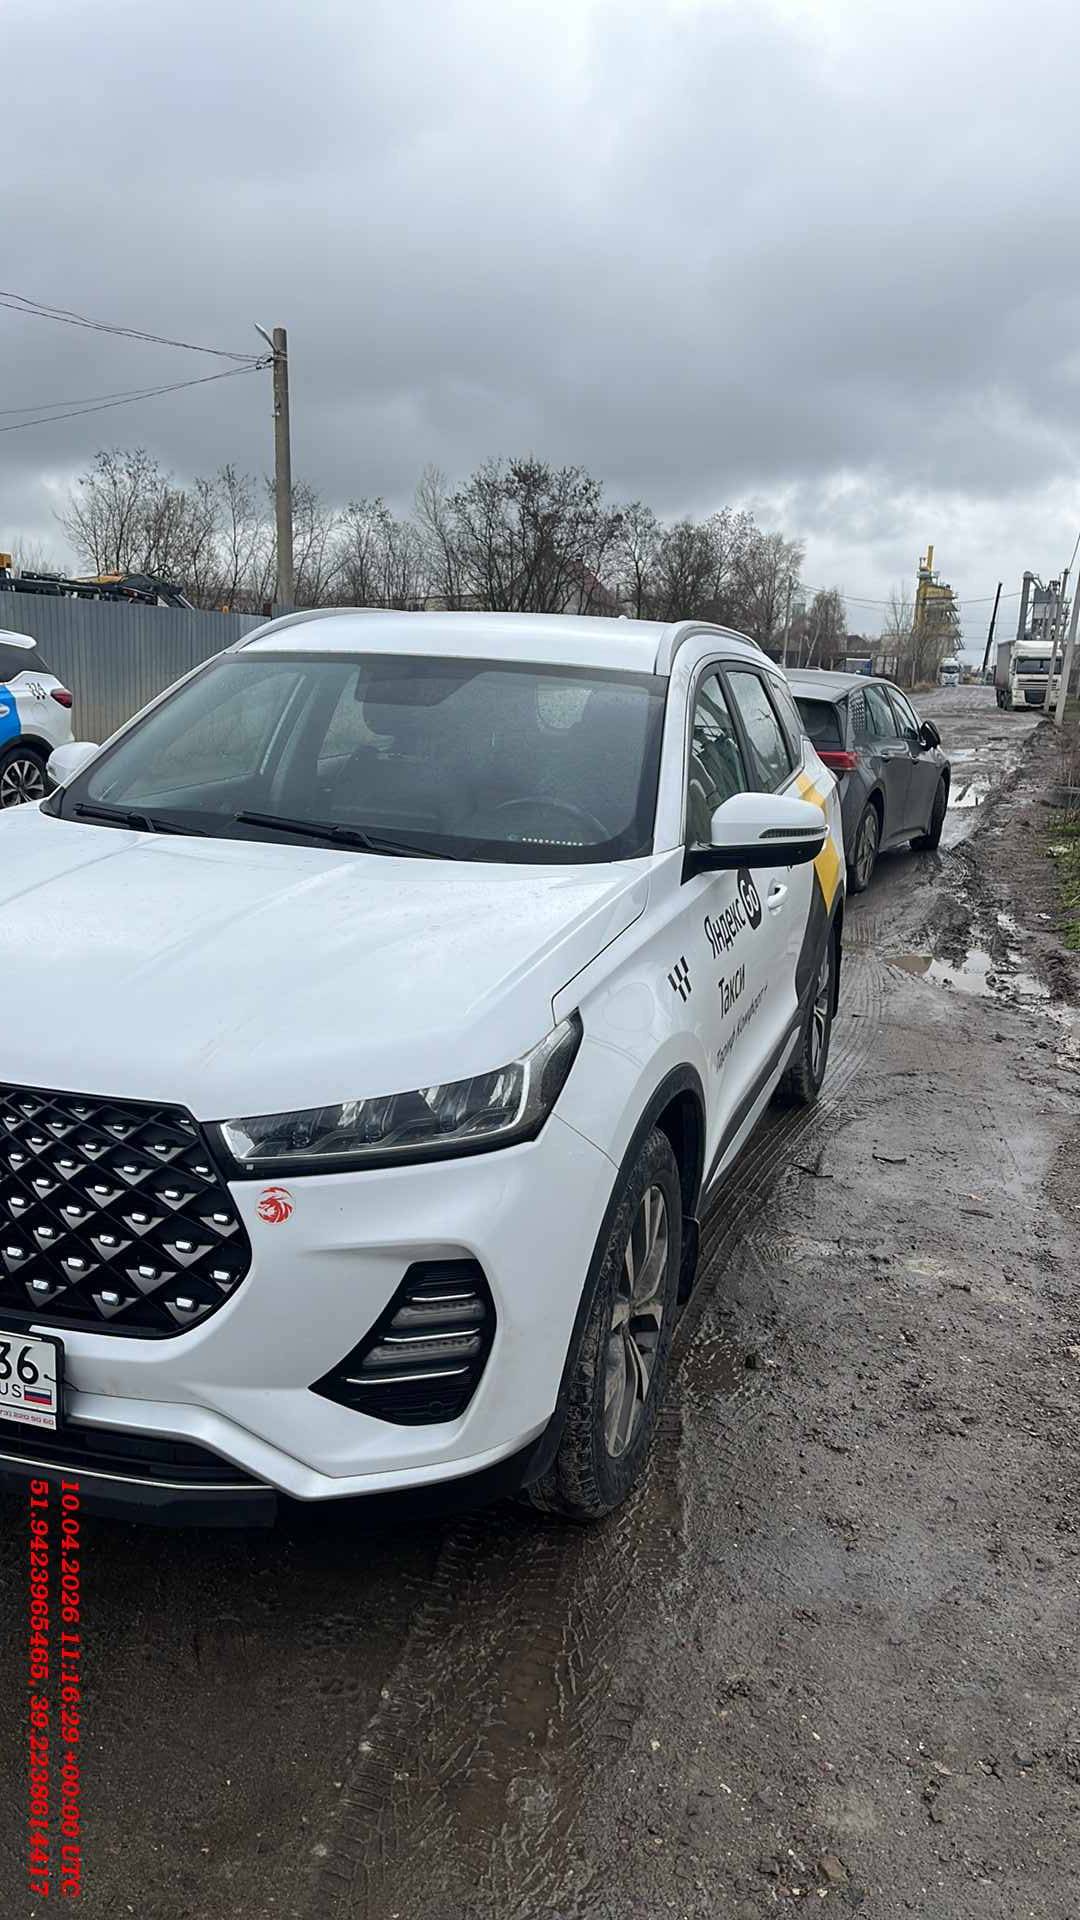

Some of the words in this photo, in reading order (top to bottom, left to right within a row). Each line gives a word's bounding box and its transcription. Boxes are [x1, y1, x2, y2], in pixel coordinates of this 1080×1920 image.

[704, 898, 746, 959] Яндекс
[739, 878, 761, 920] Go
[718, 963, 746, 1020] Такси
[0, 1342, 39, 1385] 36
